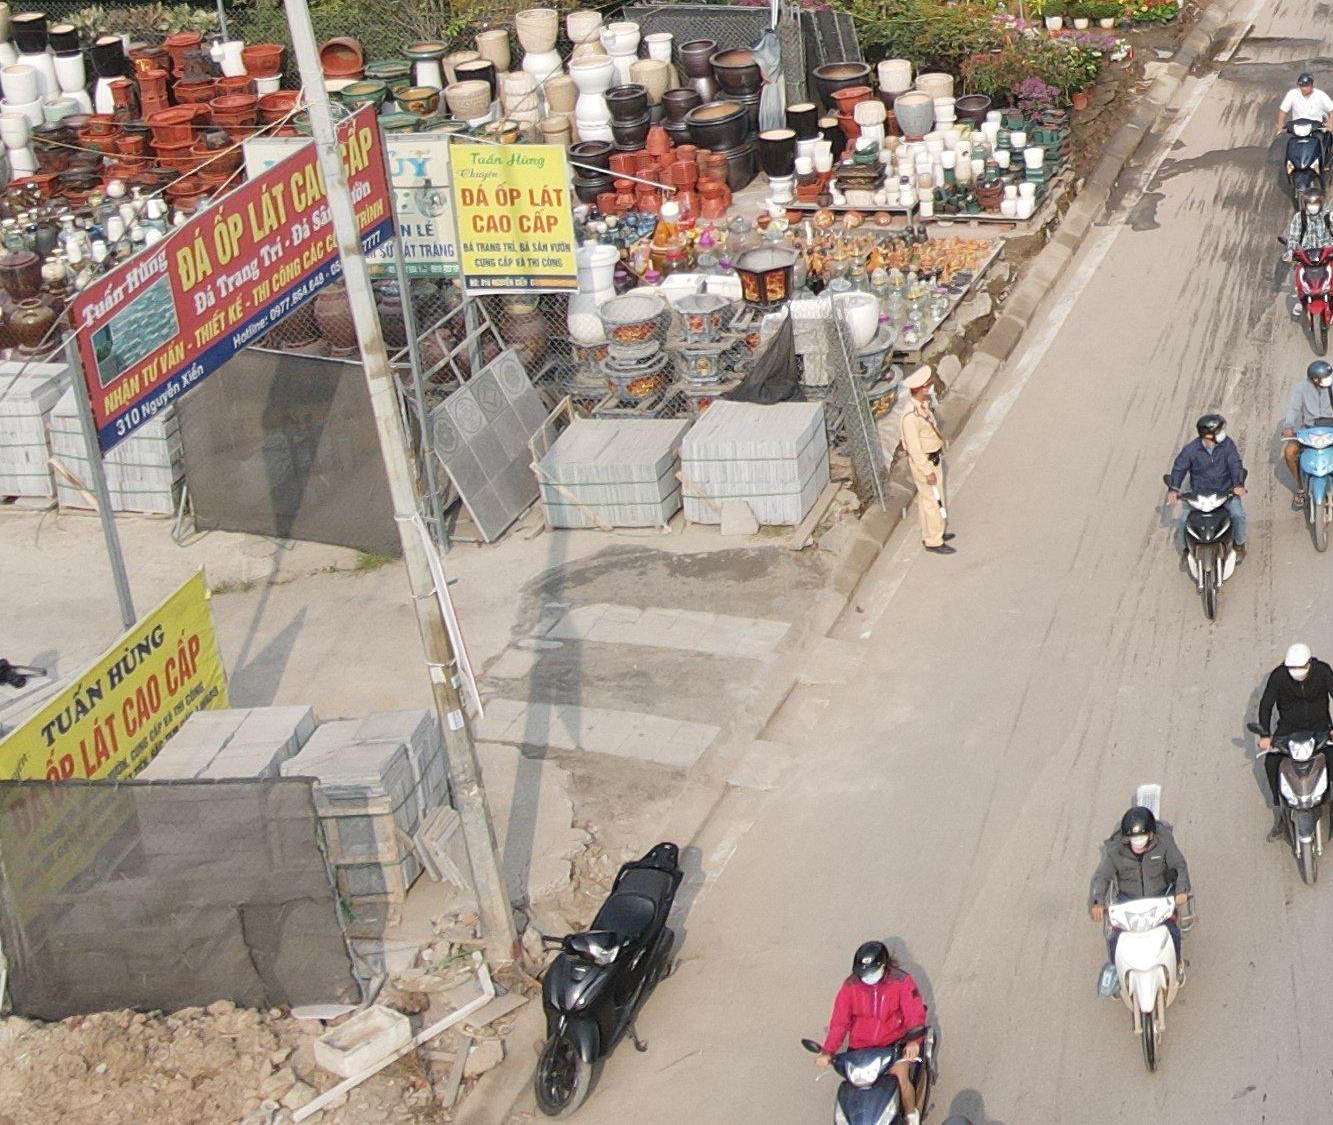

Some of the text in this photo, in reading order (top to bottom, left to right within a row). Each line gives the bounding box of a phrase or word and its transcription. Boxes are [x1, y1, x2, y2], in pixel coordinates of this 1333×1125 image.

[470, 151, 546, 169] Tuấn Hùng
[460, 181, 564, 207] ĐÁ ỐP LÁT
[471, 208, 559, 234] CAO CẤP
[176, 227, 213, 293] ĐÁ
[214, 204, 243, 266] ỐP
[246, 182, 289, 244] LÁT
[404, 242, 416, 259] ÁT
[194, 284, 216, 316] Đá
[217, 257, 261, 299] Trang
[260, 236, 284, 267] Trí
[291, 218, 311, 247] Đá
[82, 283, 126, 328] Tuấn
[104, 378, 141, 418] NHẬN
[160, 340, 185, 375] VẤN
[194, 309, 226, 349] THIẾT
[227, 294, 245, 326] KẾ
[252, 282, 271, 307] THI
[271, 259, 301, 297] CÔNG
[302, 241, 325, 270] CÁC
[115, 407, 141, 437] 310
[140, 381, 181, 421] Nguyễn
[41, 679, 105, 748] TUẤN
[106, 624, 166, 691] HÙNG
[80, 717, 120, 779] LÁT
[122, 674, 162, 738] CAO
[164, 629, 201, 698] CẤP
